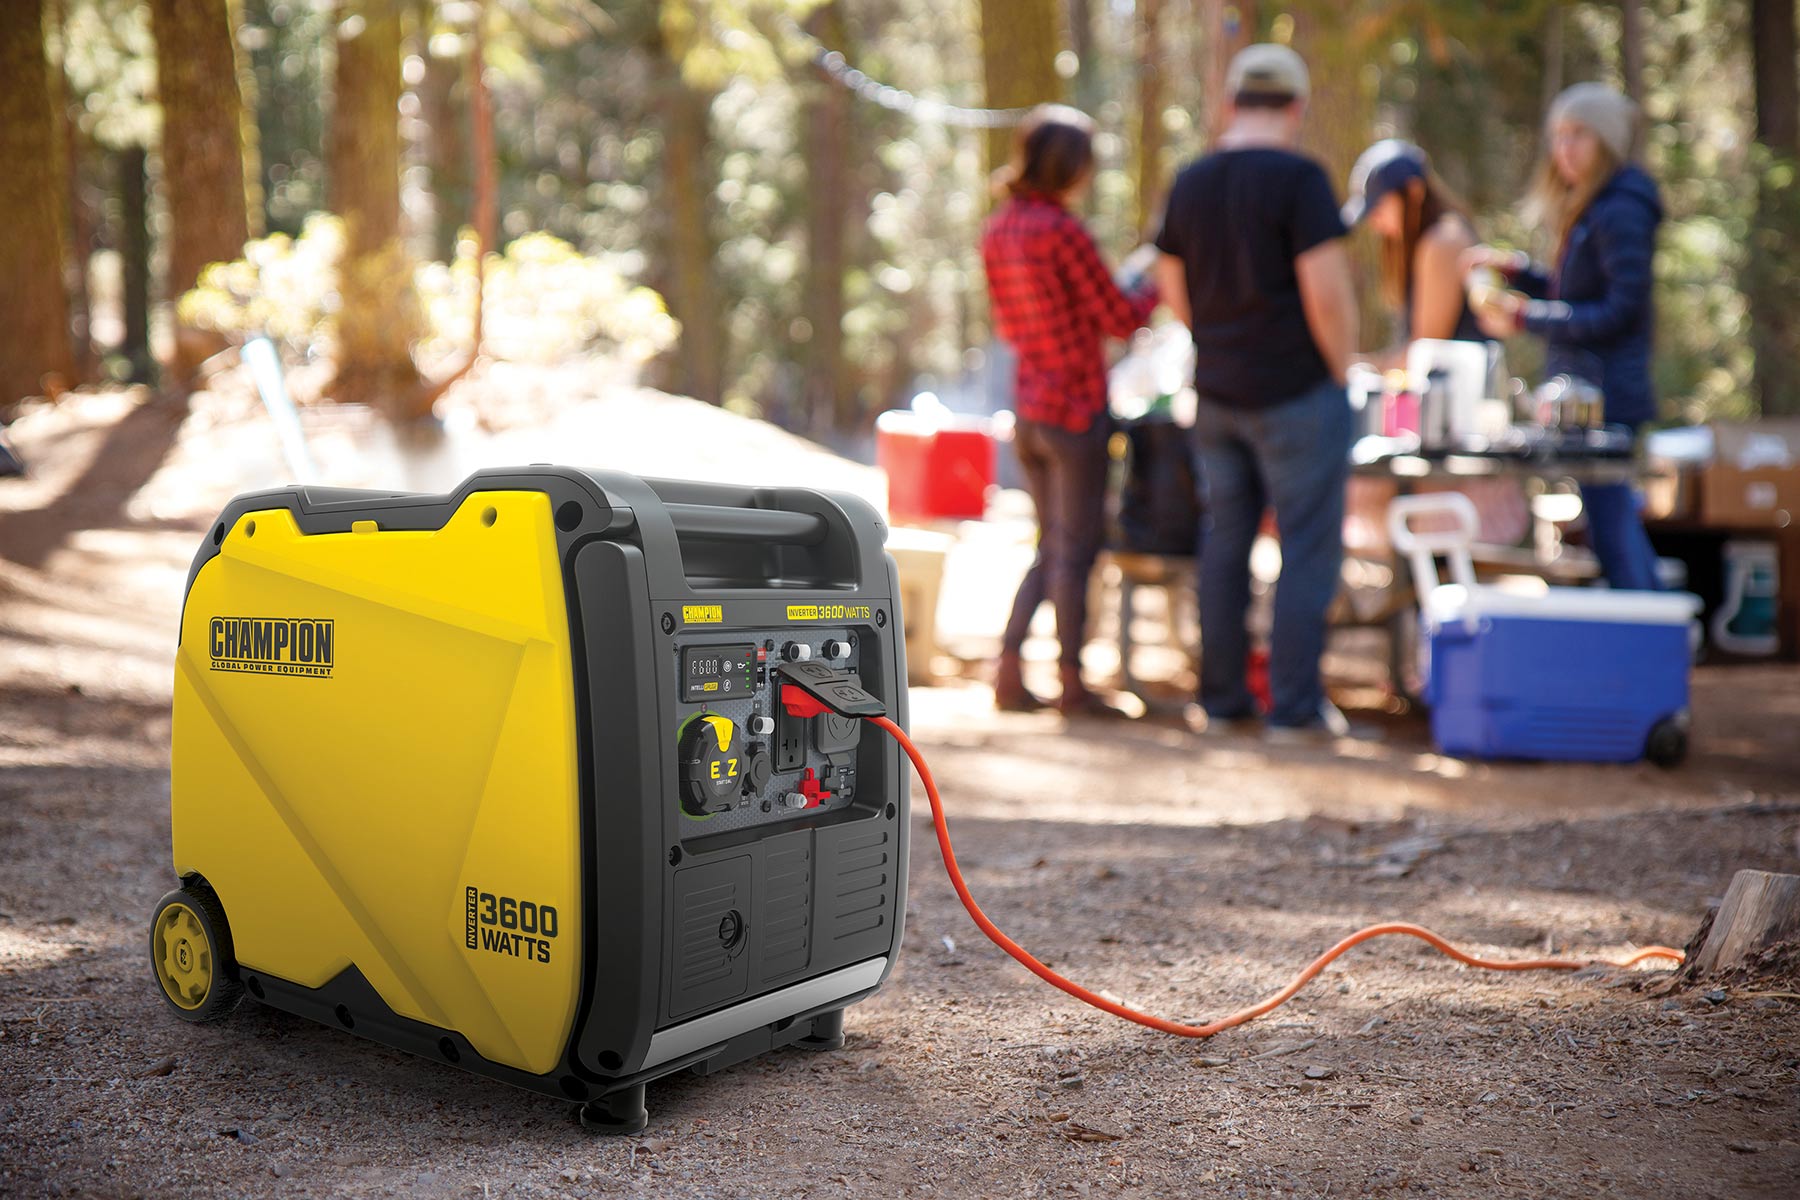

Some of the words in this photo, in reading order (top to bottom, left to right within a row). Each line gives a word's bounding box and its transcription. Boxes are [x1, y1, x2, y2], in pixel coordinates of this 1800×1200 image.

[683, 605, 722, 619] CHAMPION
[788, 607, 817, 618] INVERTER
[819, 605, 844, 619] 3600
[844, 606, 870, 619] WATTS
[210, 619, 333, 665] CHAMPION
[211, 661, 241, 670] GLOBAL
[243, 663, 273, 672] POWER
[277, 665, 331, 676] EQUIPMENT
[467, 888, 477, 948] INVERTER
[479, 892, 558, 938] 3600
[481, 927, 550, 964] WATTS
